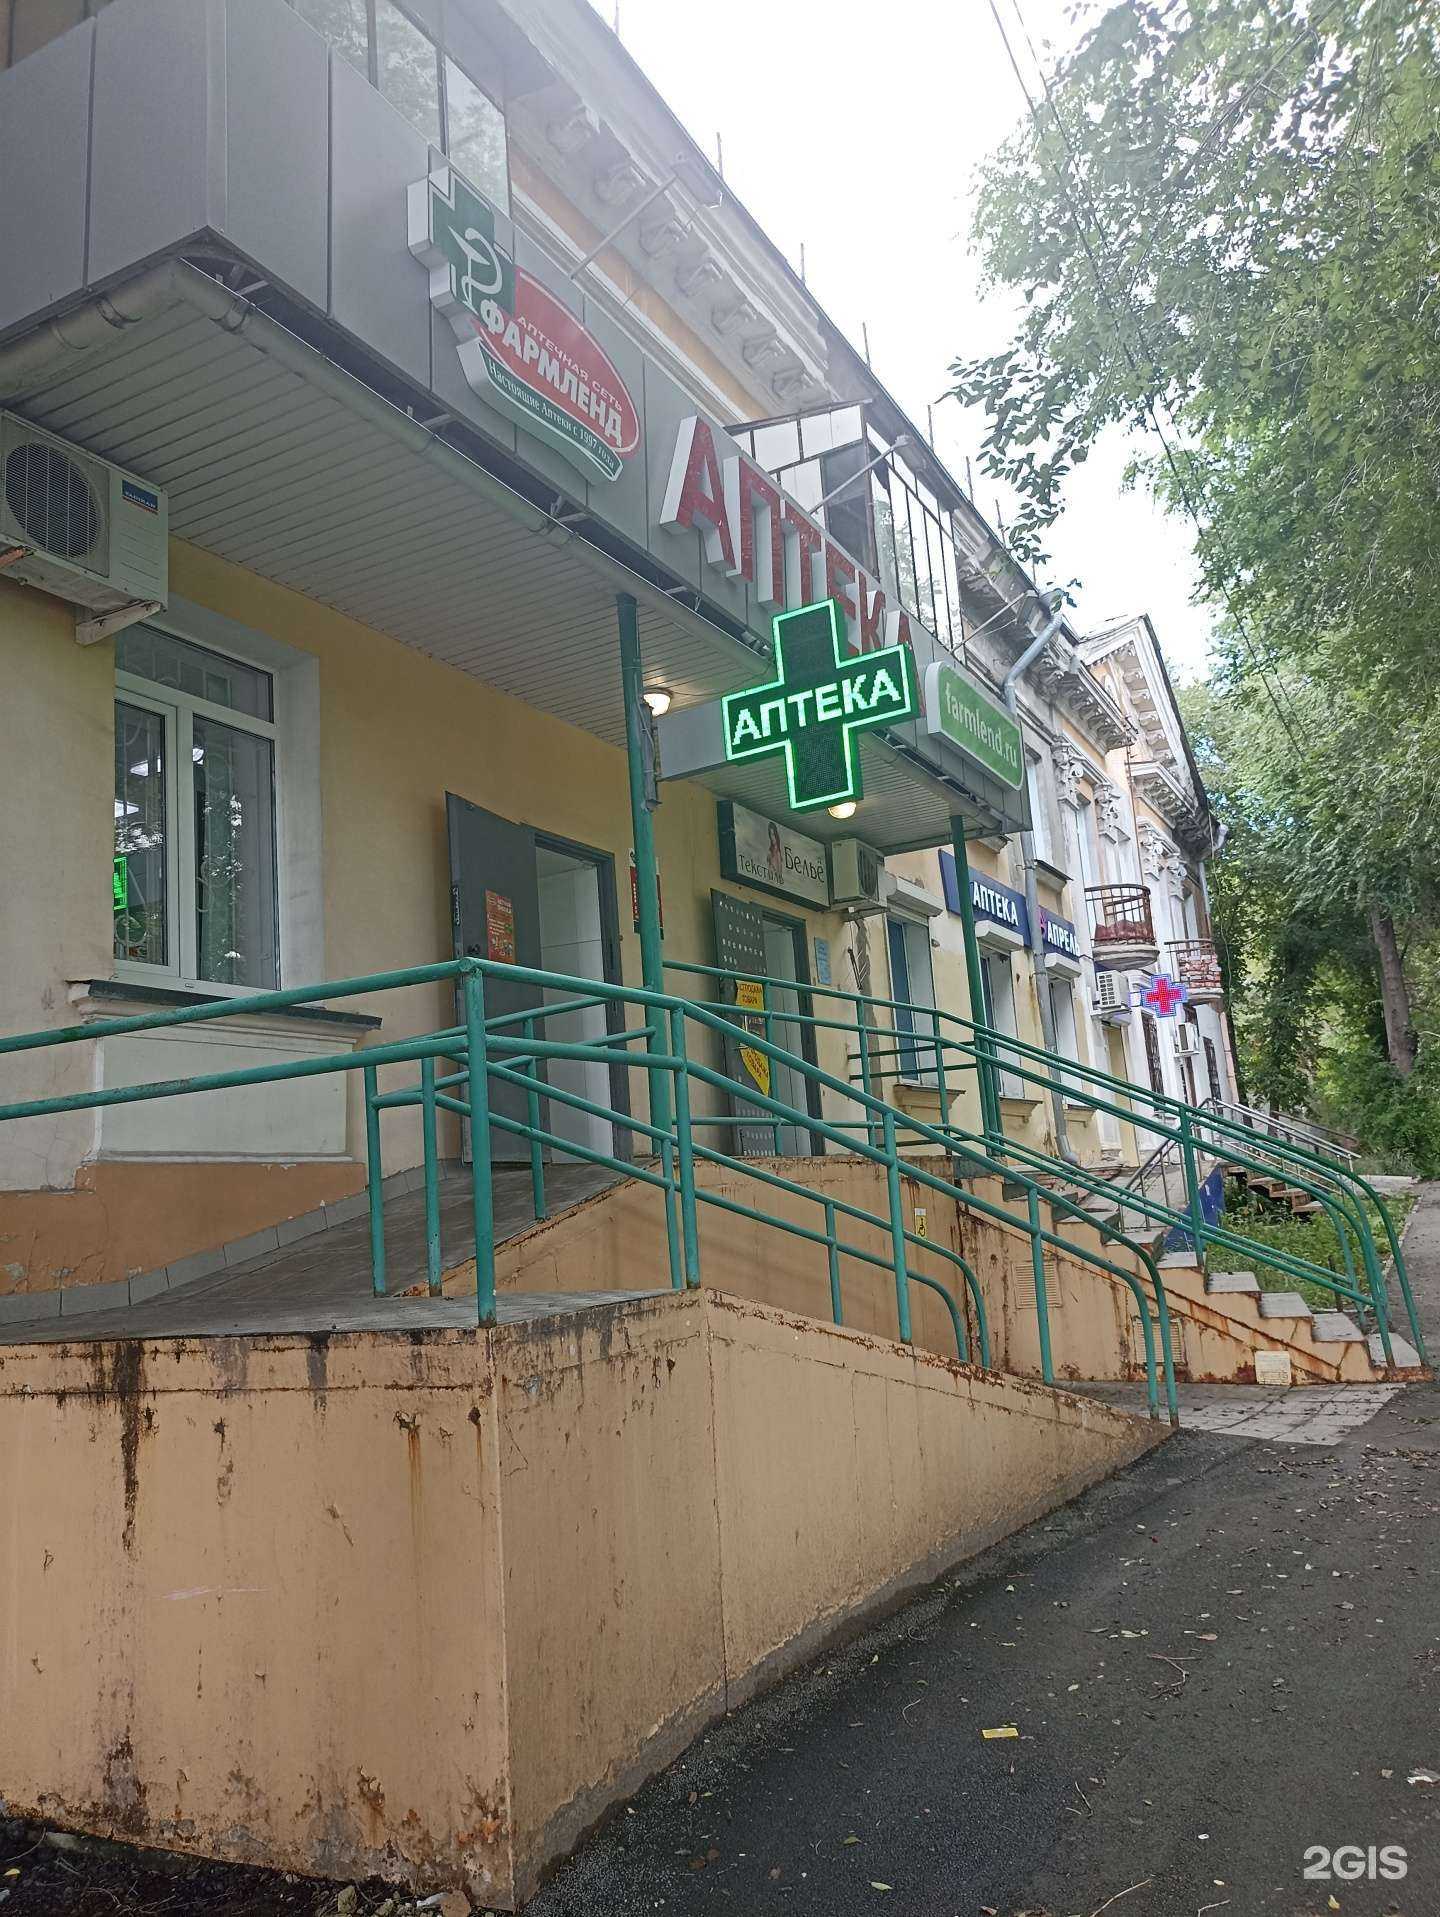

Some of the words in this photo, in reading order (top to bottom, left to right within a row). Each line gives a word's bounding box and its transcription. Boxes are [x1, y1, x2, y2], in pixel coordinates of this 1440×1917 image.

[480, 298, 622, 449] ФАРМЛЕНД
[488, 359, 540, 411] Настоящие
[541, 402, 573, 432] Аптеки
[580, 429, 598, 449] 1997
[517, 316, 589, 381] АПТЕЧНАЯ
[592, 381, 622, 412] СЕТЬ
[732, 668, 902, 746] АПТЕКА
[945, 682, 1018, 769] farmlend.ru
[739, 854, 784, 885] Текстиль
[784, 846, 825, 883] Бельё
[973, 881, 1019, 927] АПТЕКА
[1047, 920, 1080, 957] АПРЕЛЬ
